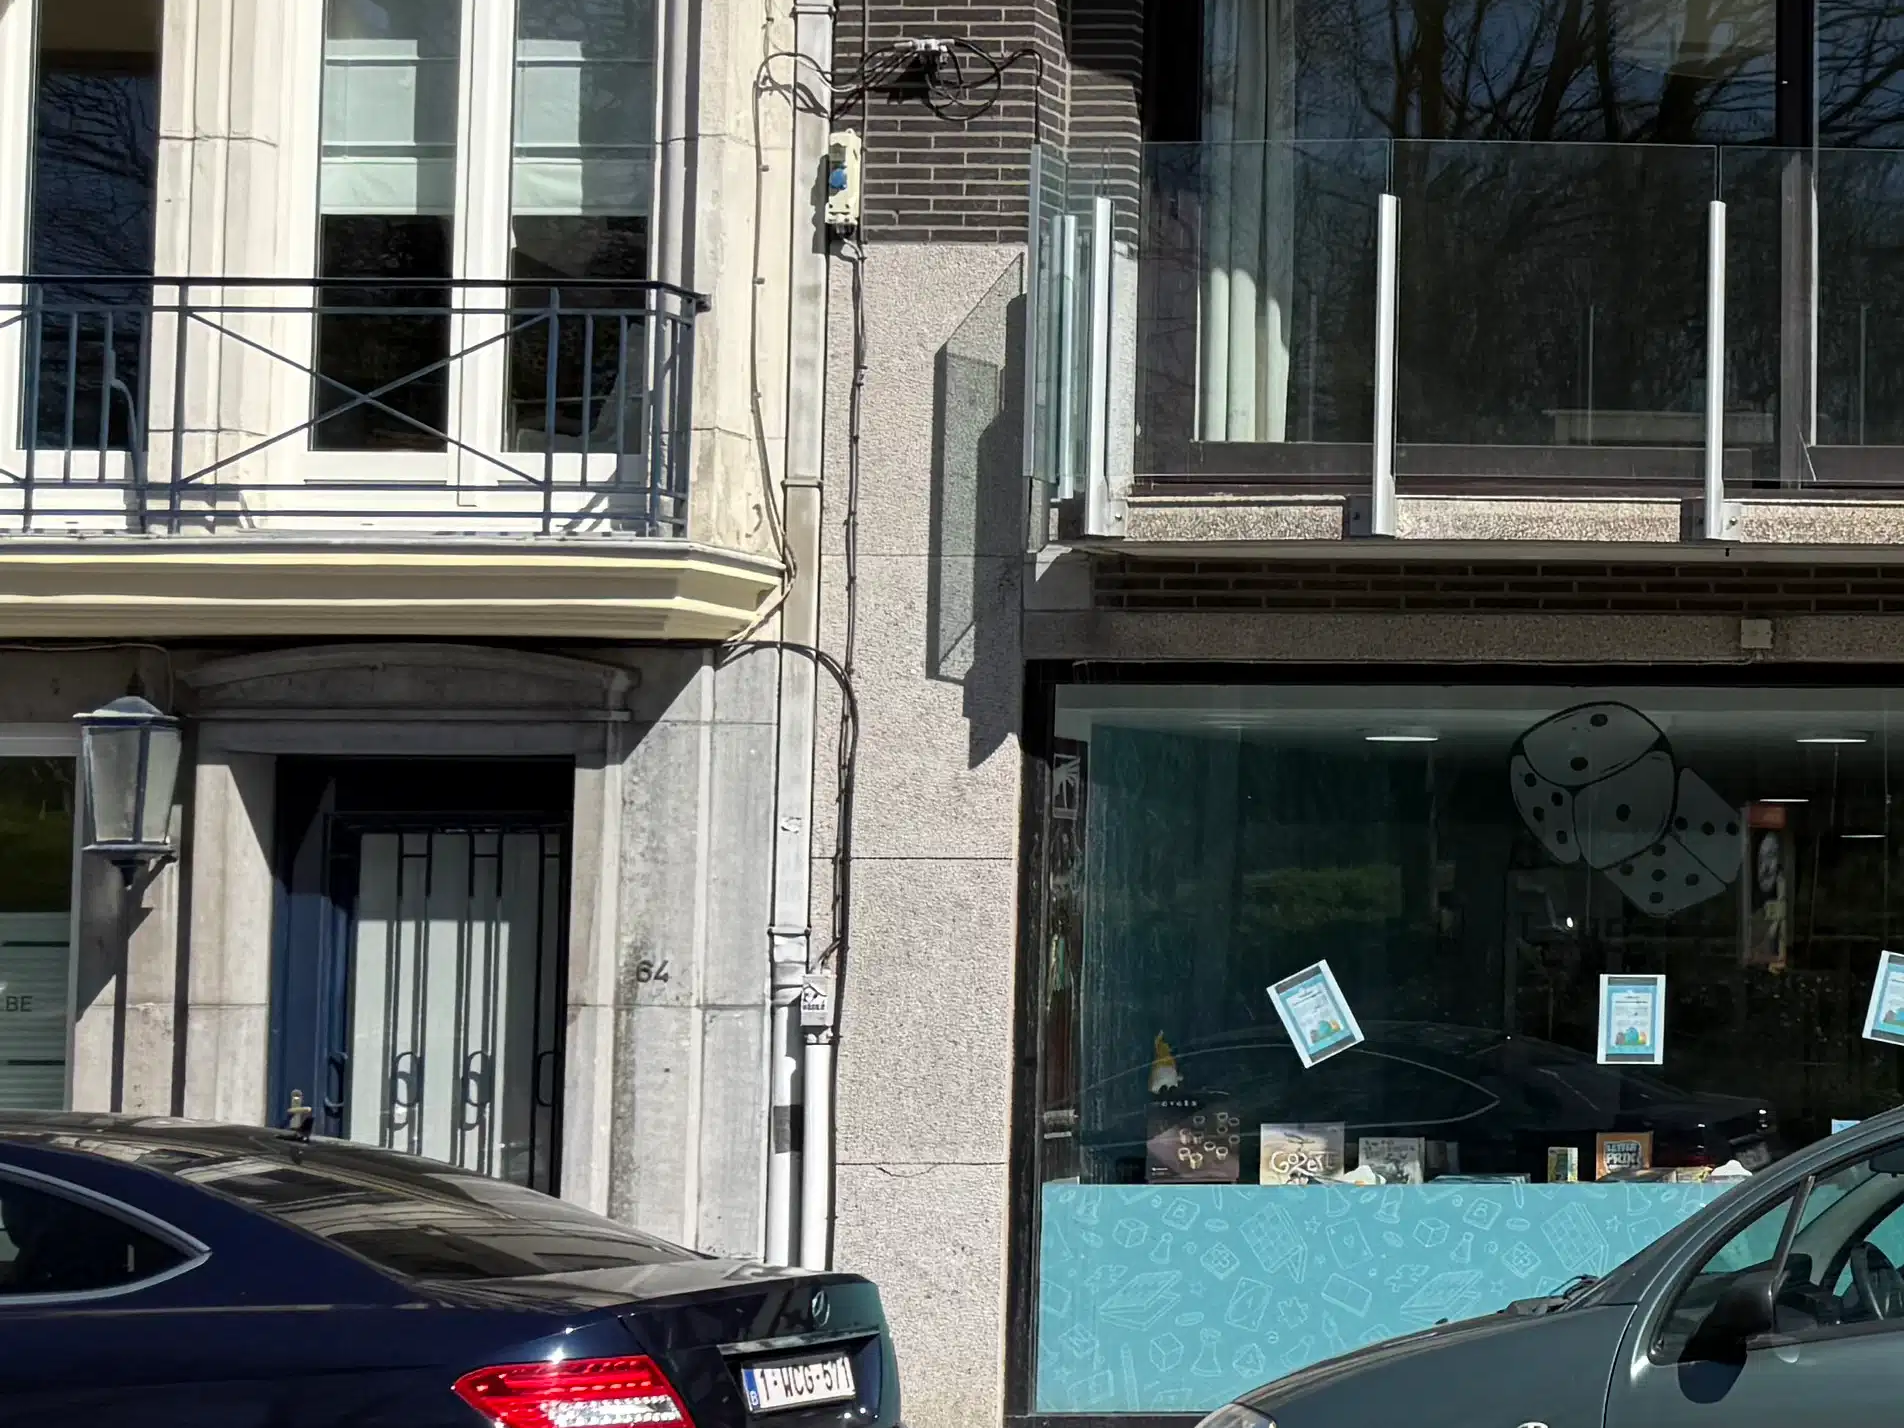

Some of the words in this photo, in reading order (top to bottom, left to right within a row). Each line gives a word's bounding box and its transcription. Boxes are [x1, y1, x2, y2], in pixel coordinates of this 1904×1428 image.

[636, 959, 669, 983] 64
[6, 996, 33, 1012] BE
[750, 1390, 760, 1406] B
